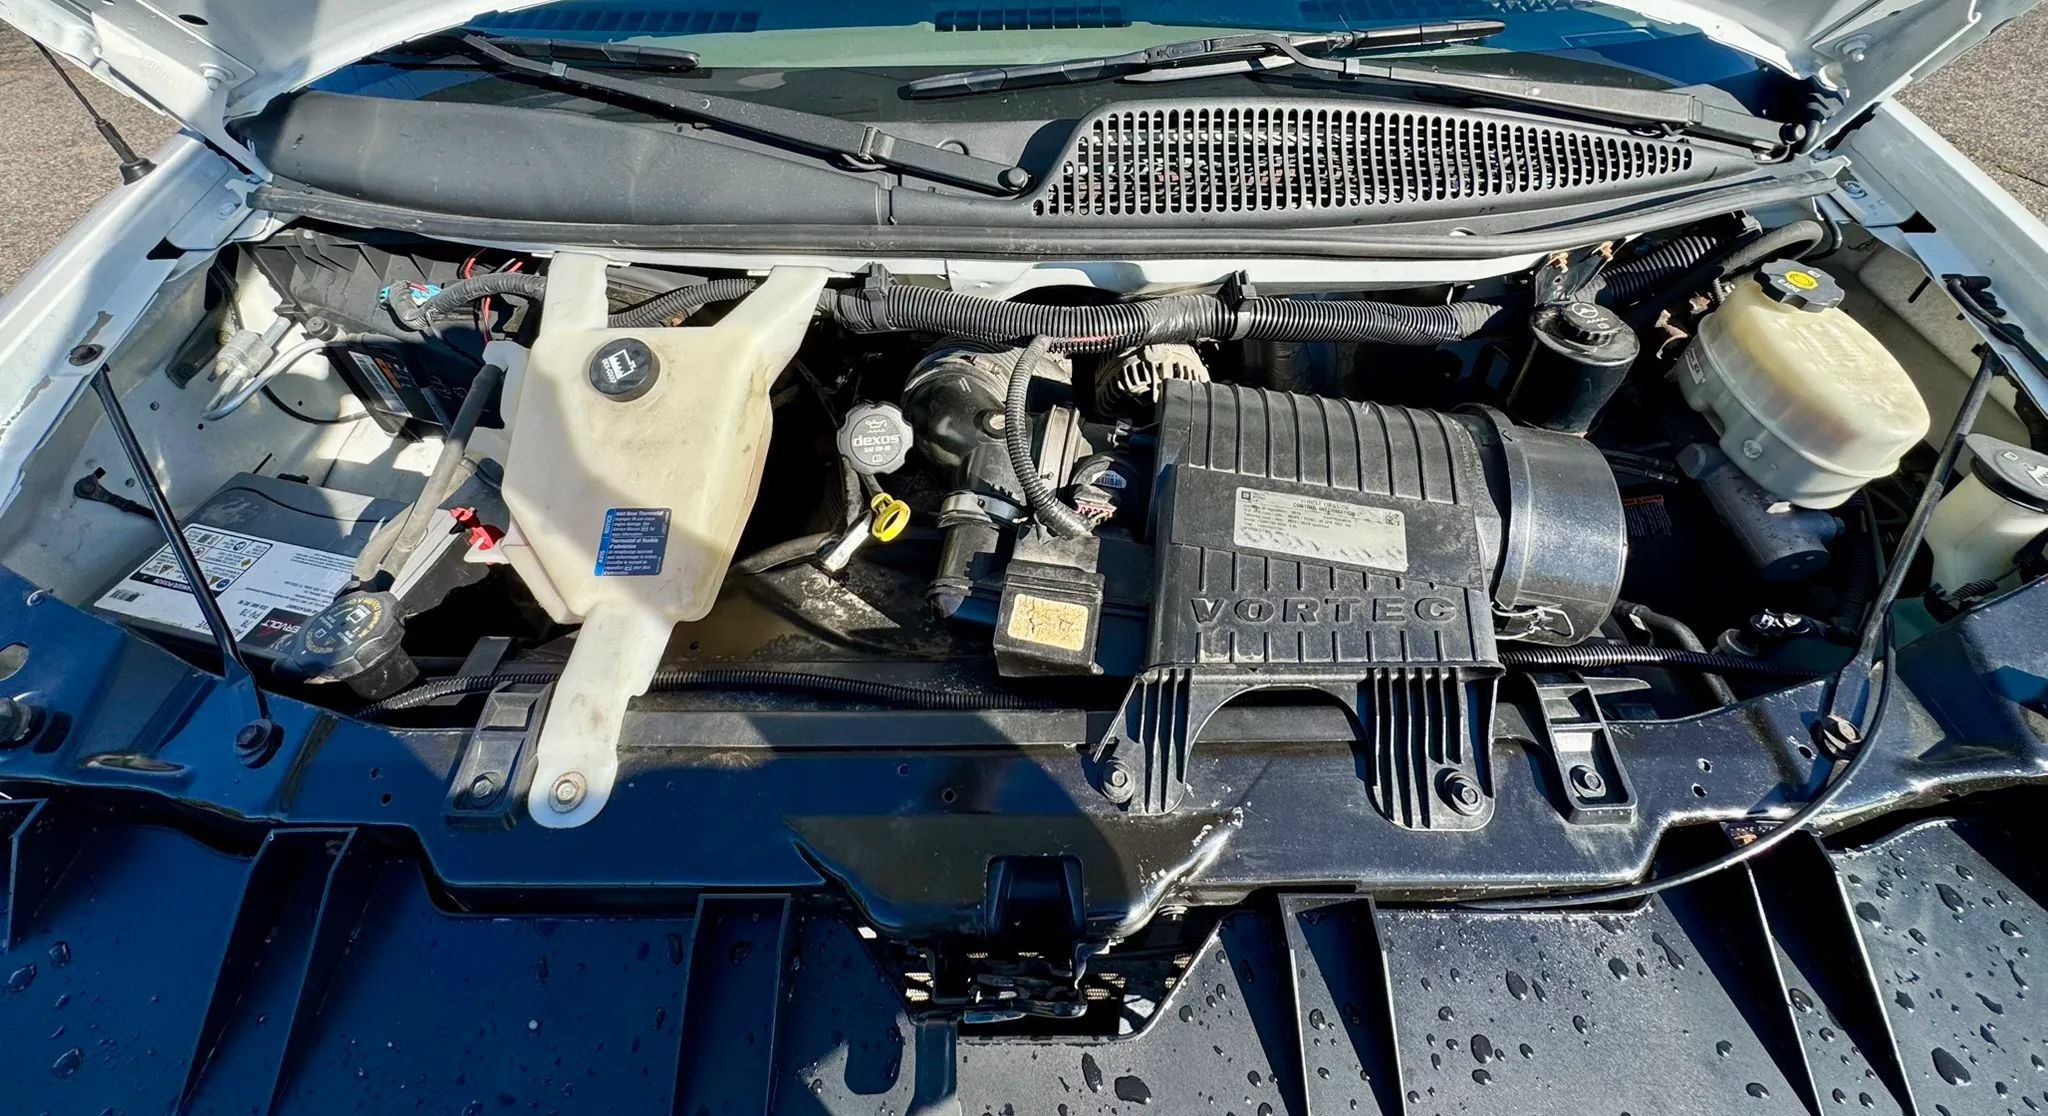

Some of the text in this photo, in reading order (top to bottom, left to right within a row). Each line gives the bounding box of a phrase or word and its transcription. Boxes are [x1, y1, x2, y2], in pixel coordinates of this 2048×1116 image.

[1783, 283, 1801, 293] DOT
[853, 434, 901, 446] dexos
[1293, 503, 1317, 511] CONTROL
[1190, 597, 1457, 623] VORTEC
[261, 619, 301, 634] ERVOLT
